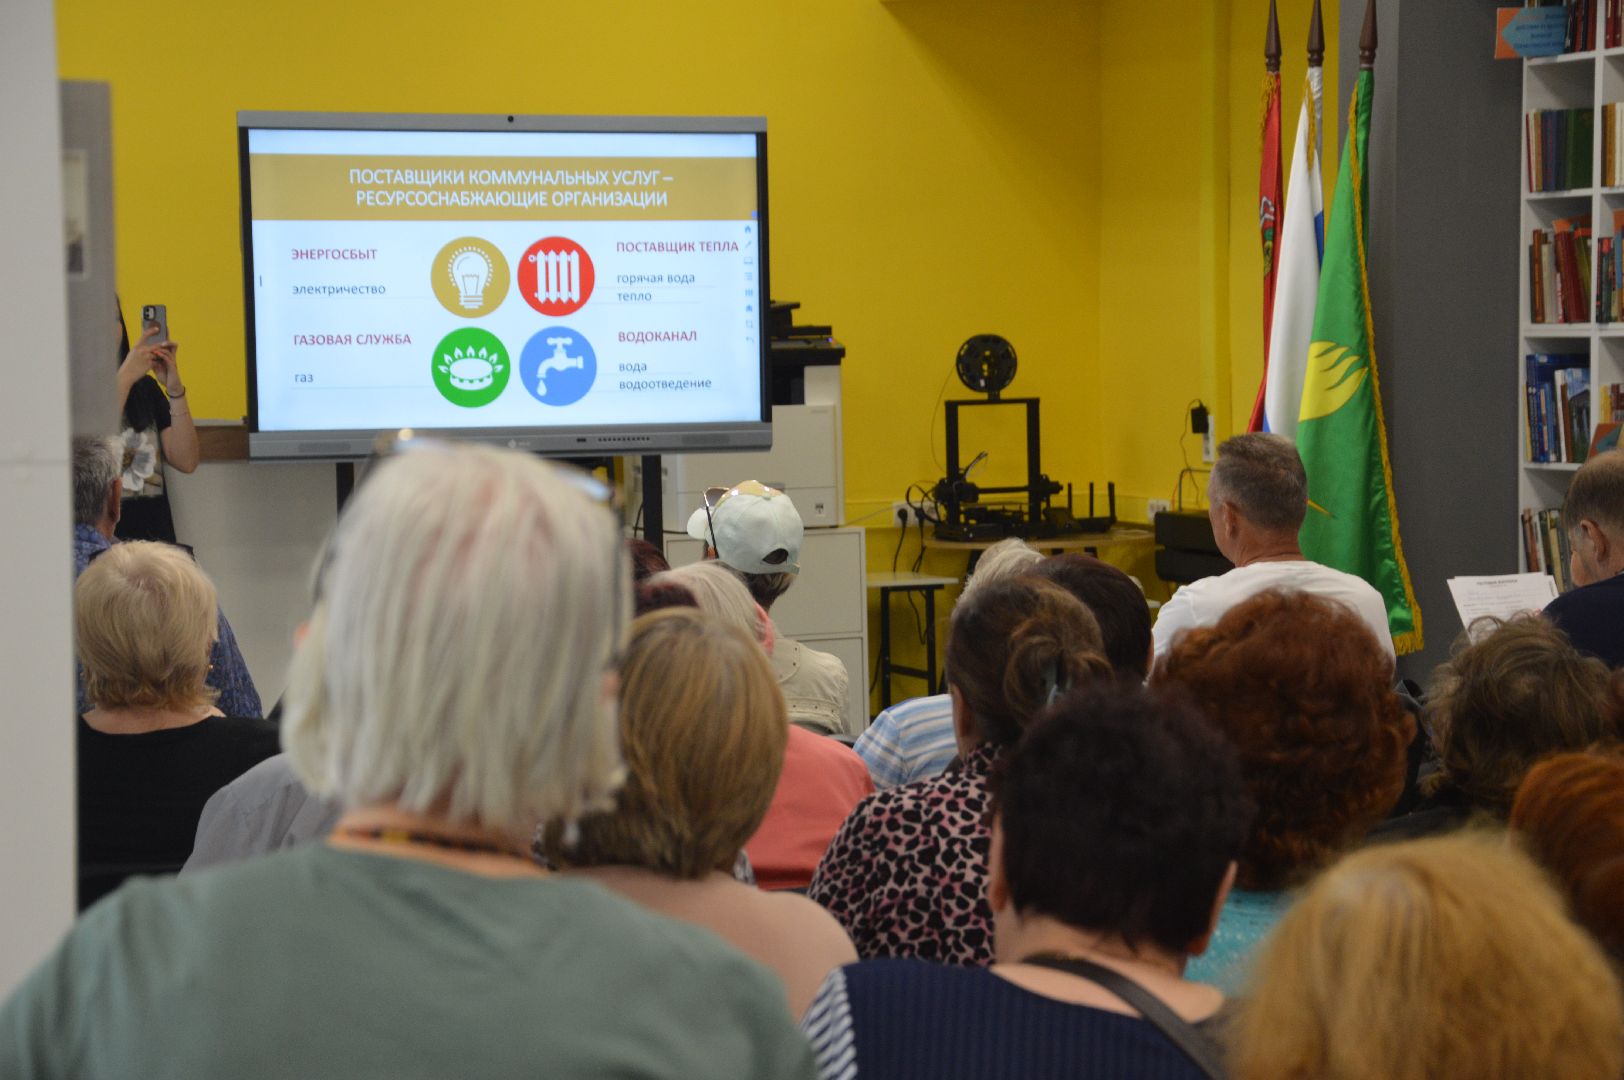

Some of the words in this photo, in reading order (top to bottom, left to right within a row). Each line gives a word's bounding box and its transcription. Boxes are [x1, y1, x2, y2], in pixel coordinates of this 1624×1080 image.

[349, 168, 465, 187] ПОСТАВЩИКИ
[469, 169, 609, 186] КОММУНАЛЬНЫХ
[612, 169, 661, 186] УСЛУГ
[356, 190, 548, 209] РЕСУРСОСНАБЖАЮЩИЕ
[551, 190, 668, 209] ОРГАНИЗАЦИИ
[616, 241, 696, 254] ПОСТАВЩИК
[699, 240, 740, 252] ТЕПЛА
[291, 248, 378, 260] ЭНЕРГОСБЫТ
[616, 273, 664, 285] горячая
[667, 273, 696, 285] вода
[291, 284, 386, 296] электричество
[617, 292, 652, 302] тепло
[293, 334, 352, 346] ГАЗОВАЯ
[356, 333, 412, 345] СЛУЖБА
[618, 330, 697, 343] ВОДОКАНАЛ
[618, 361, 648, 373] вода
[294, 373, 314, 383] газ
[619, 379, 712, 391] водоотведение
